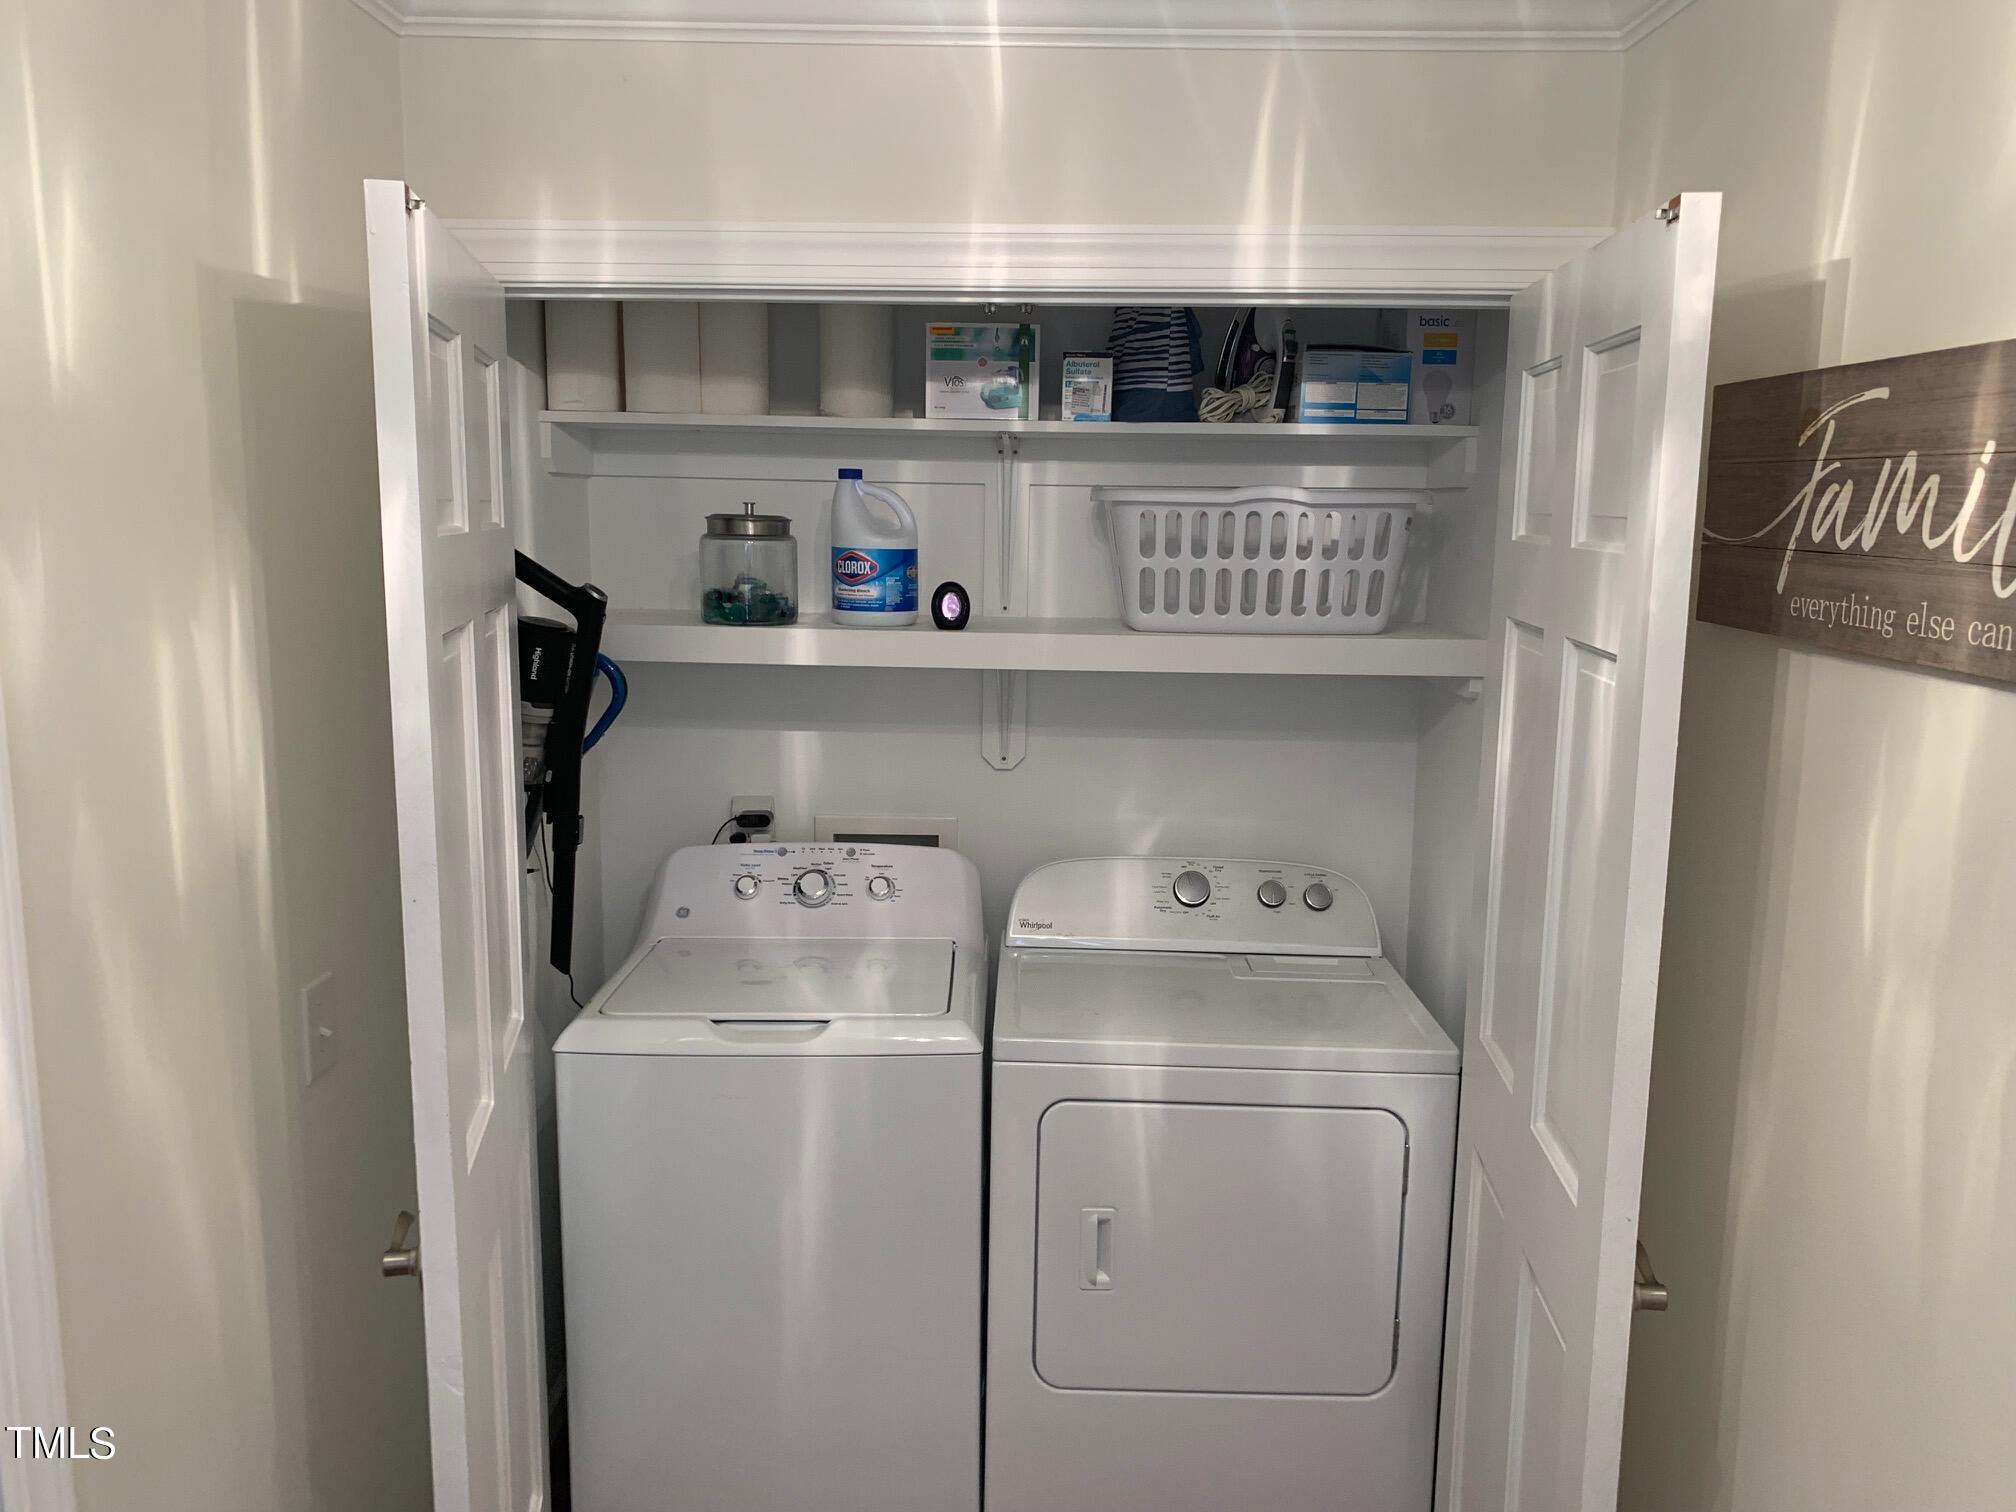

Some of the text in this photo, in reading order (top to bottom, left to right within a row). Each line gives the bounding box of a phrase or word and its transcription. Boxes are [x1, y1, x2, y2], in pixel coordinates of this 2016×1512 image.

[1419, 315, 1450, 327] basic
[1065, 360, 1100, 368] Albuterol
[837, 560, 871, 574] CLOROX
[1790, 593, 2013, 651] everything else can
[530, 647, 542, 680] Highland
[1019, 921, 1053, 930] Whirlpool
